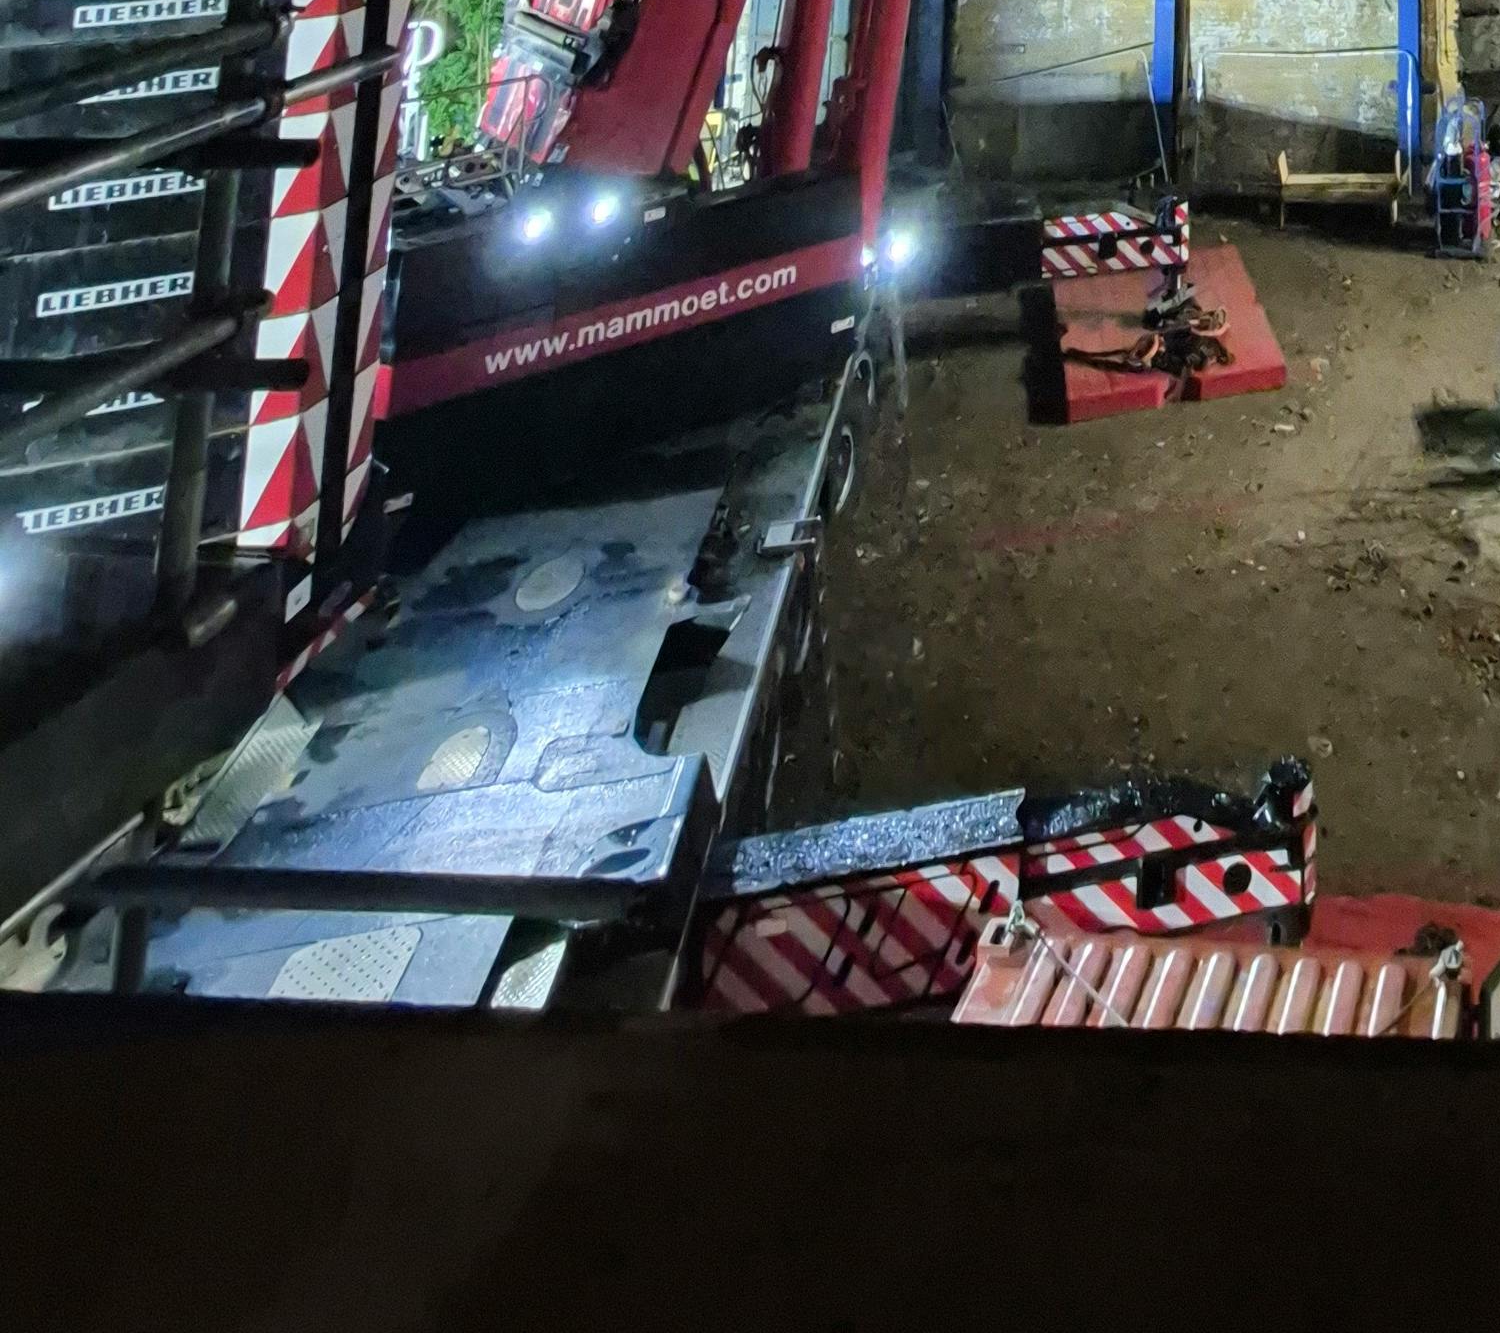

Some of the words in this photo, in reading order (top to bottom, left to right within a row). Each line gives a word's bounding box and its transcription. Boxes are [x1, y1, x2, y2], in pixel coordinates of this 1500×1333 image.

[54, 174, 200, 206] LIEBHER
[42, 276, 192, 313] LIEBHER
[484, 264, 798, 374] www.mammoet.com
